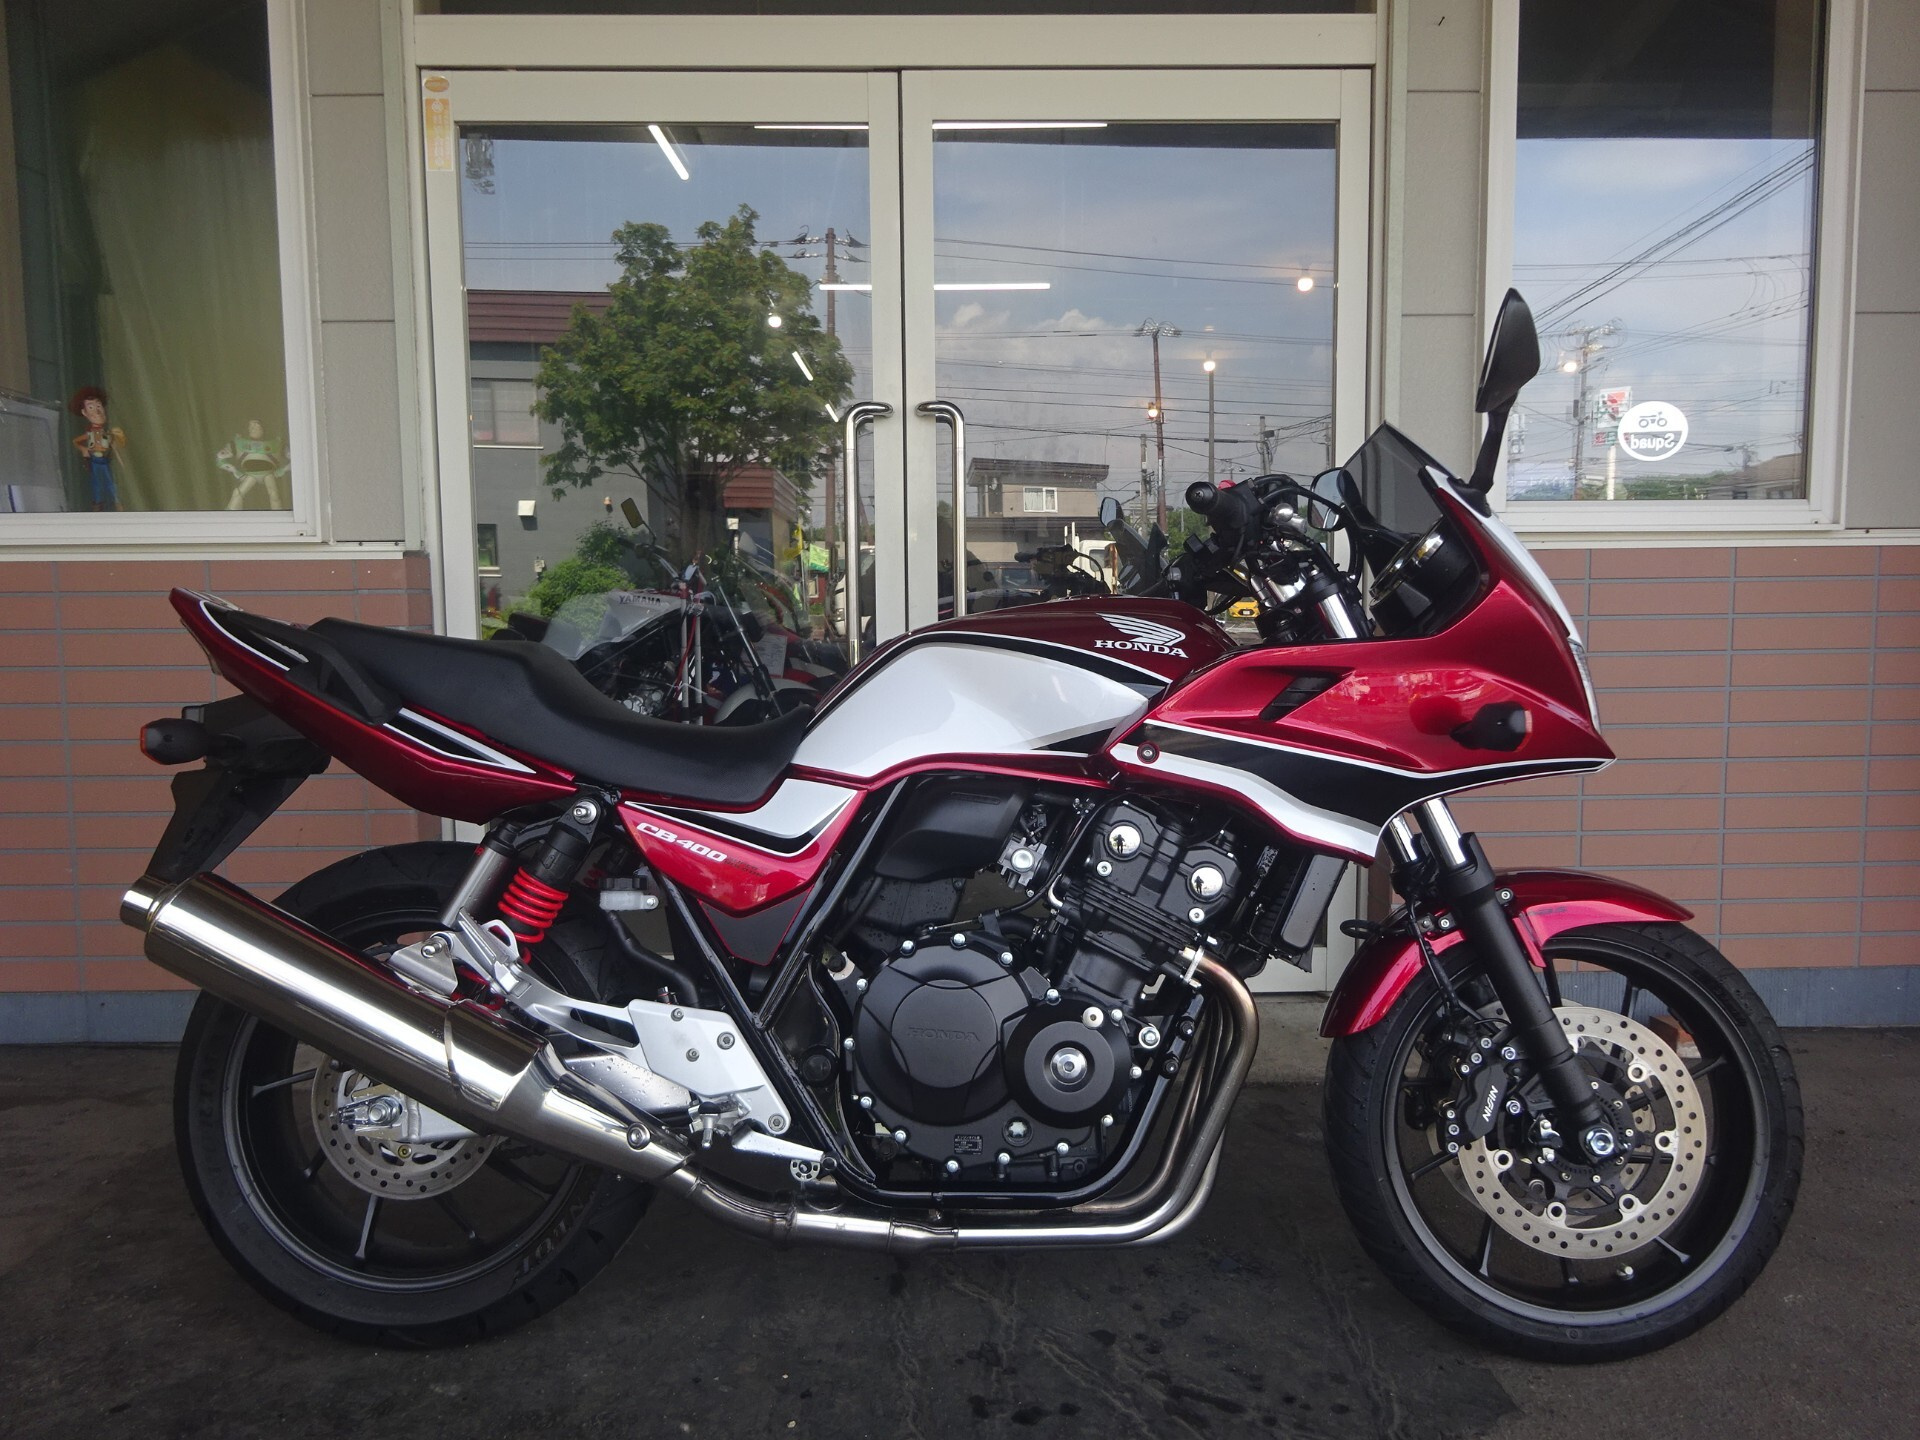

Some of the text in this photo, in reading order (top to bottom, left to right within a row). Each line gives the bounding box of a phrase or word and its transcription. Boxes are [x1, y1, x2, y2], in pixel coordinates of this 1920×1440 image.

[1094, 640, 1189, 659] HONDA
[636, 822, 728, 862] CB400
[907, 1026, 981, 1042] HONDA
